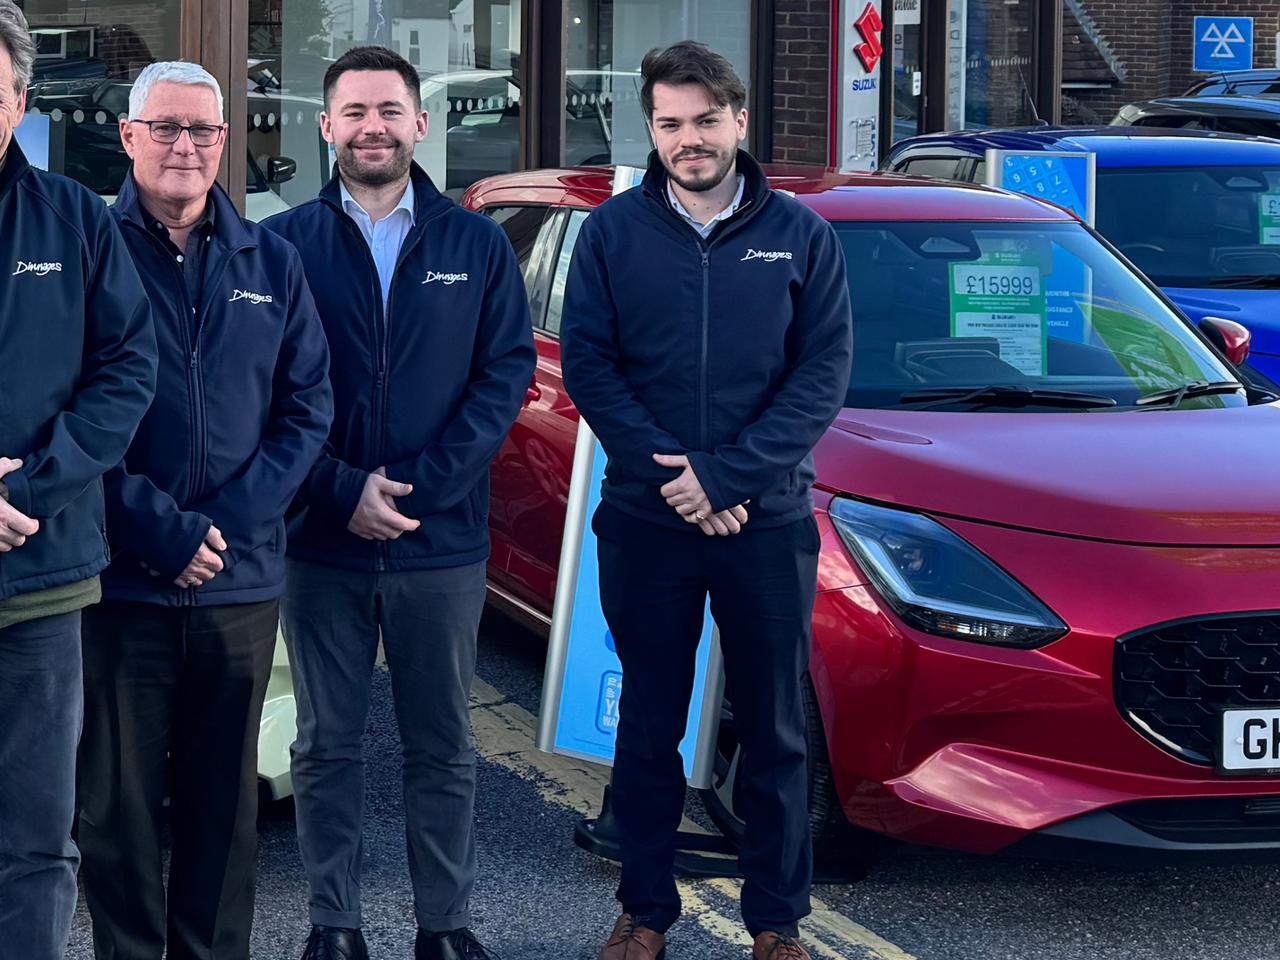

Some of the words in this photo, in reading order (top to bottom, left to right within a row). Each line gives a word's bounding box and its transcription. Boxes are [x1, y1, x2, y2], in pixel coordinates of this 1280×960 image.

[740, 248, 793, 262] Dinnages
[12, 260, 63, 276] Dinnages
[421, 270, 468, 285] Dinnages
[966, 275, 1033, 295] £15999
[228, 289, 273, 304] Dinnages
